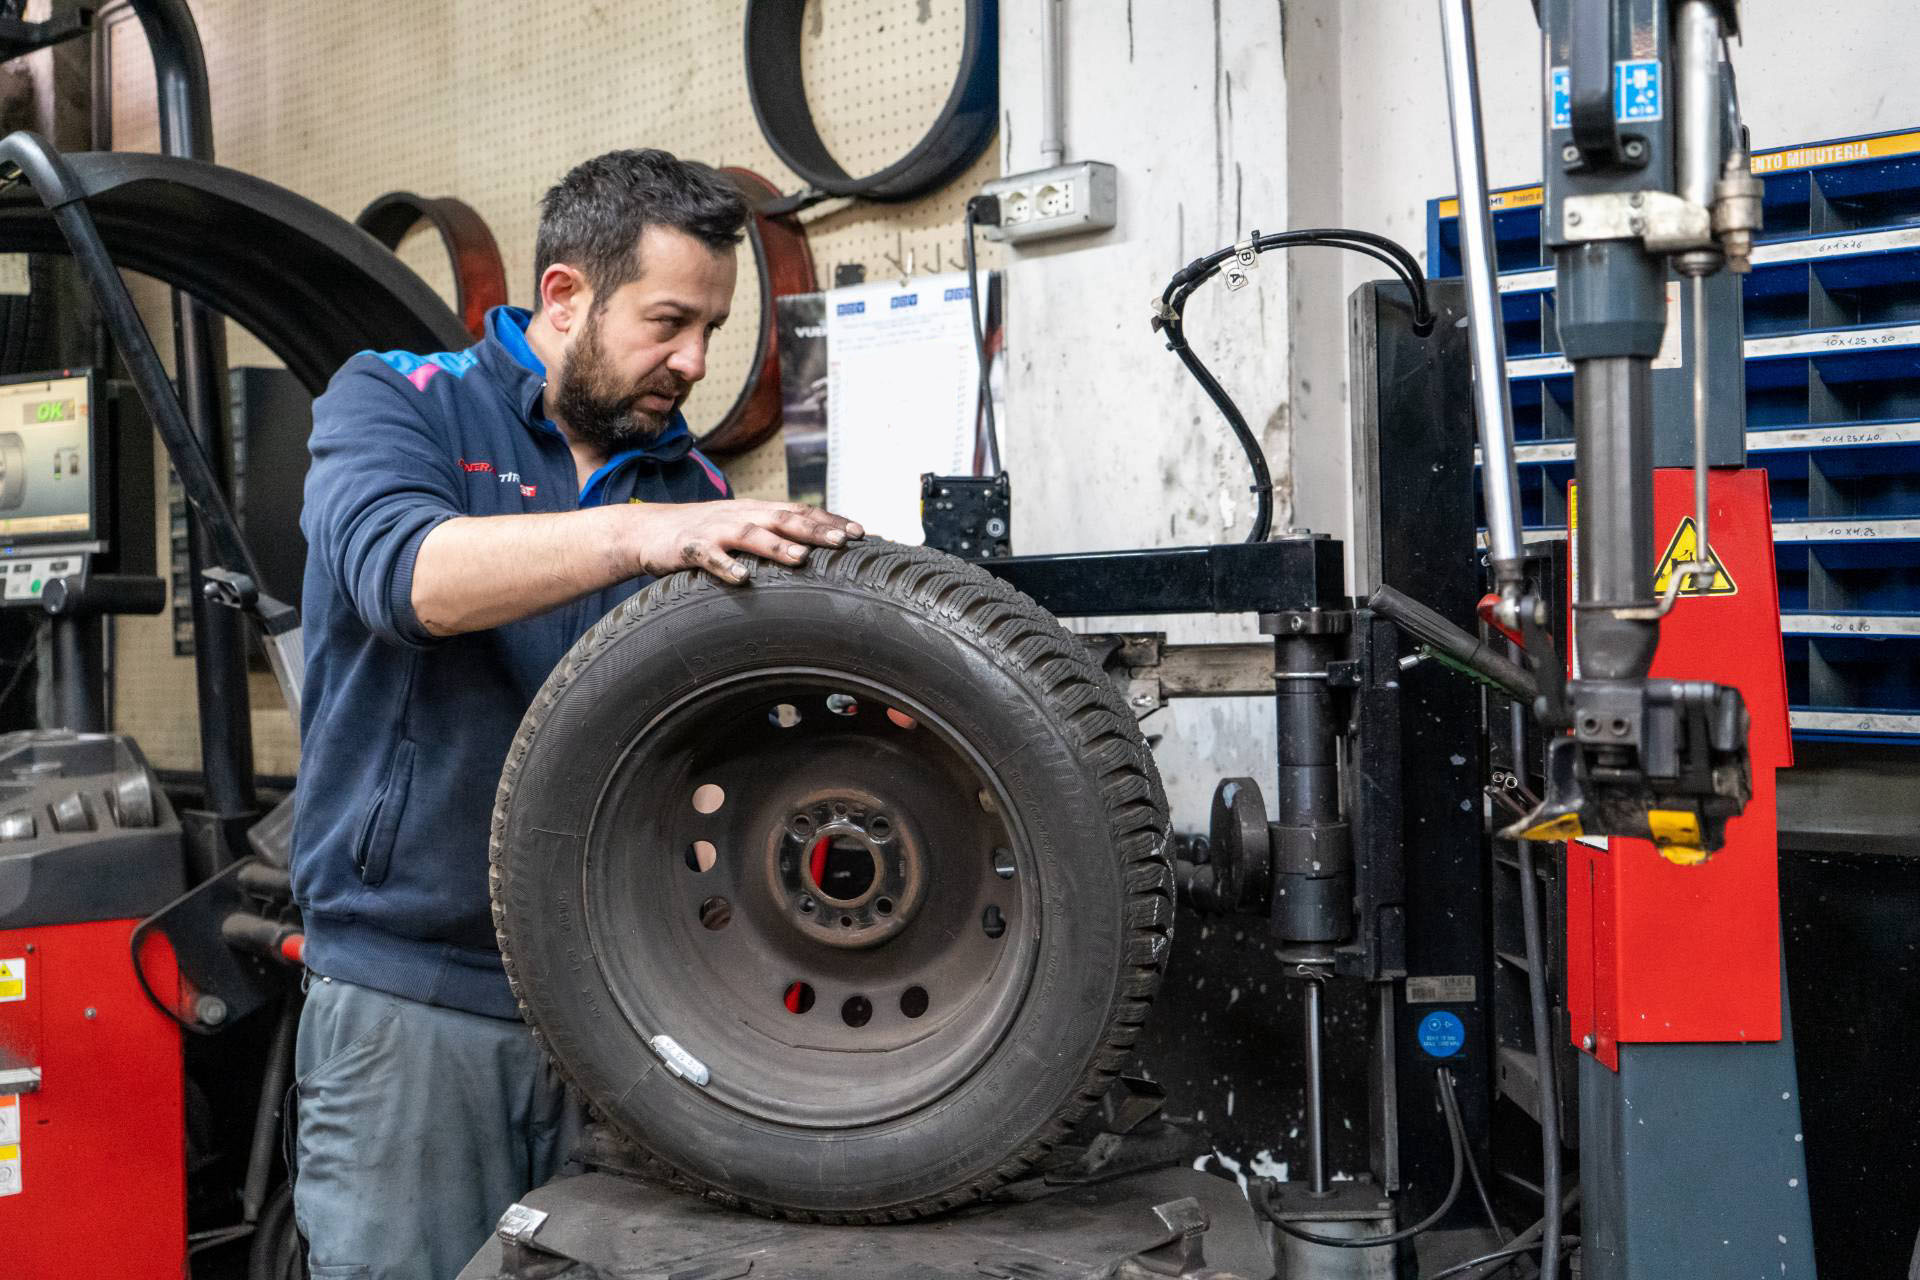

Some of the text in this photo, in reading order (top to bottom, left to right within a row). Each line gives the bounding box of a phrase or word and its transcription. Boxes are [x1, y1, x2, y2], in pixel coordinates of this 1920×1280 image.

[1750, 142, 1870, 171] ENTO MINUTERIA
[1241, 252, 1252, 261] B
[1230, 273, 1241, 283] A
[36, 402, 65, 422] OK
